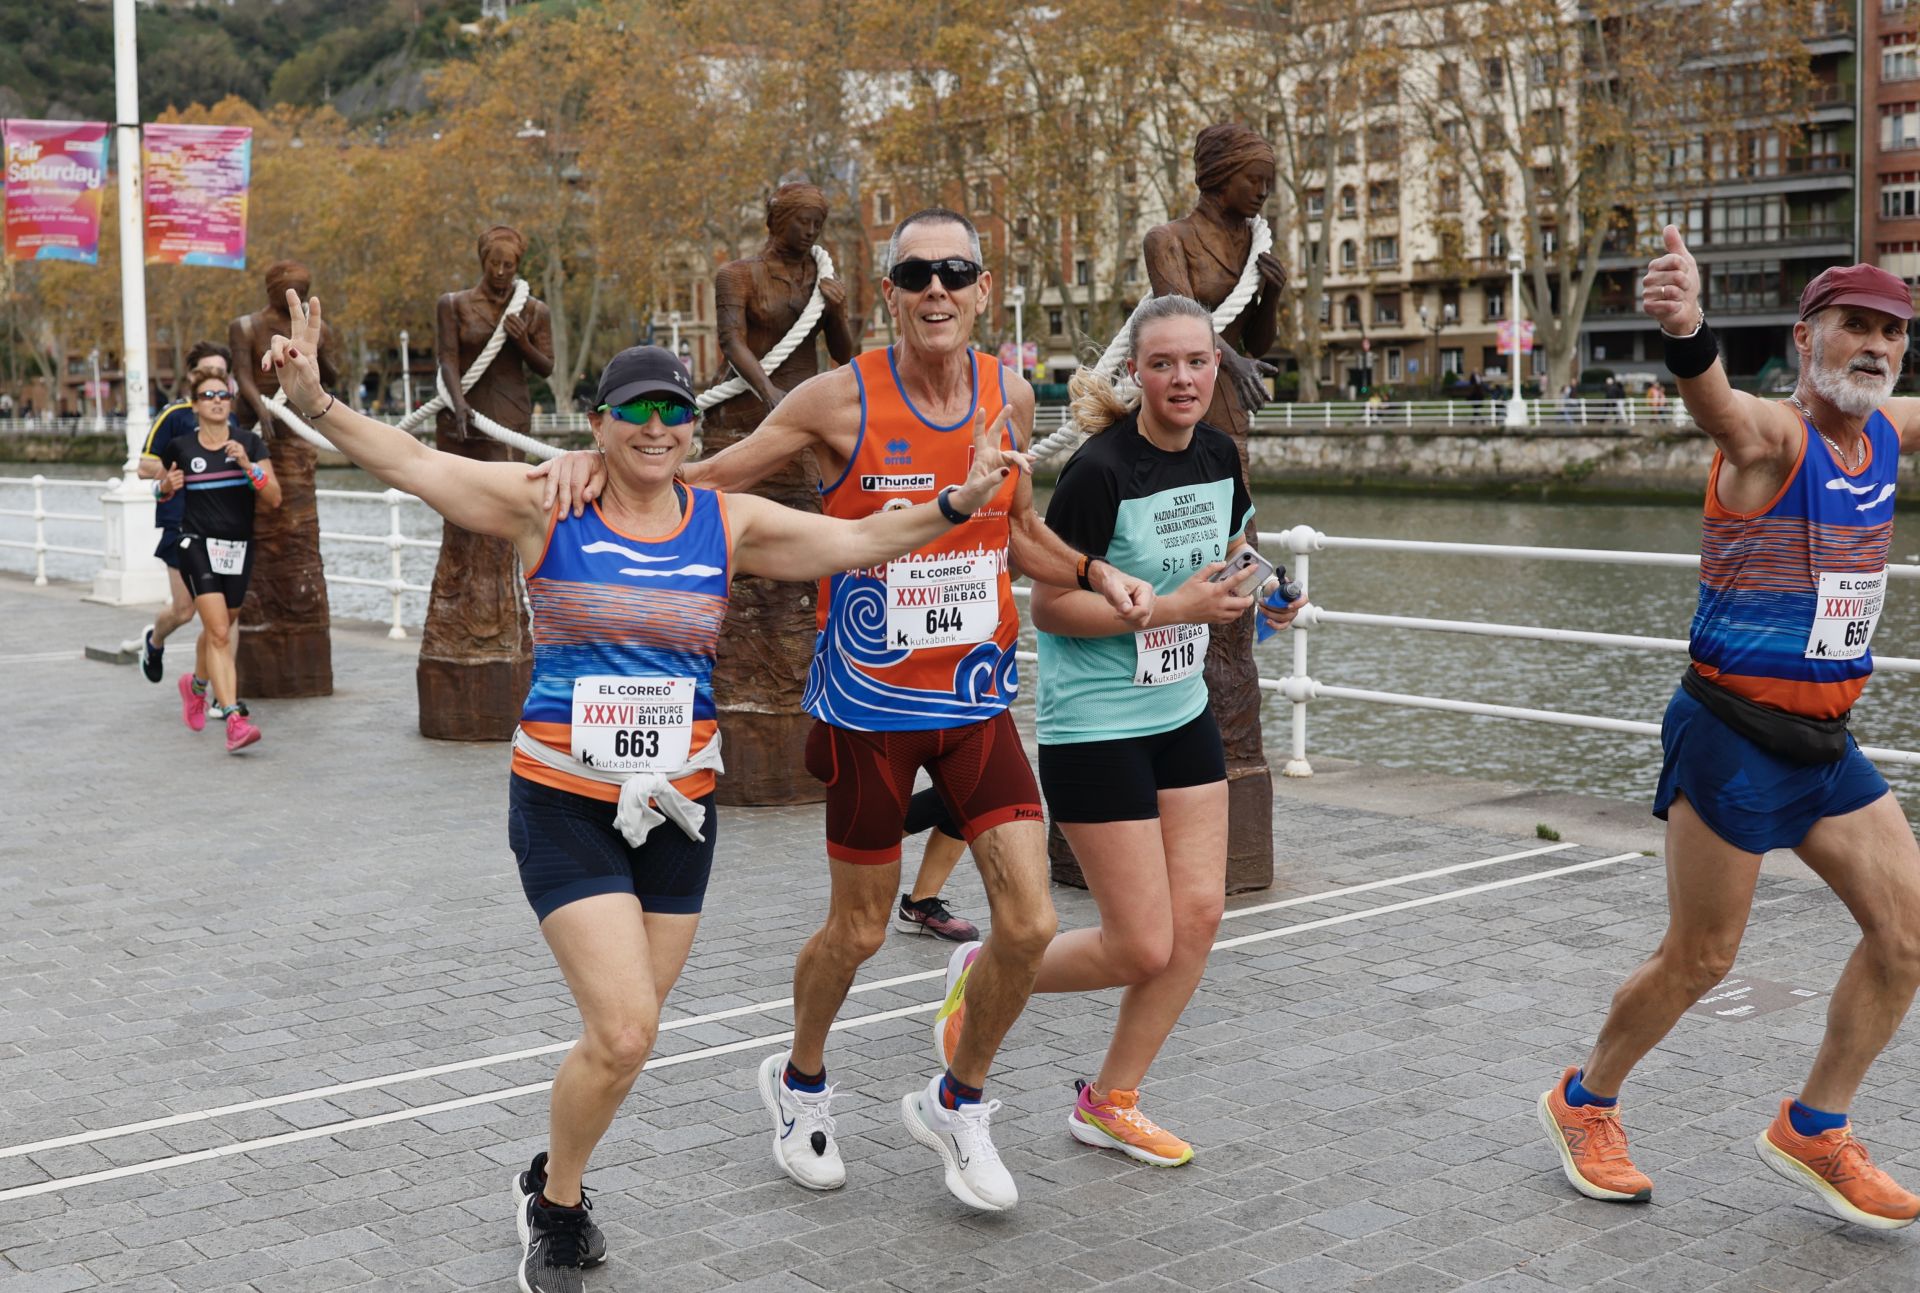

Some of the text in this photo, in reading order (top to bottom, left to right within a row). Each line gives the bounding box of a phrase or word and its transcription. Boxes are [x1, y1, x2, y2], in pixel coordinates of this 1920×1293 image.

[9, 141, 43, 161] Fair
[8, 161, 101, 189] Saturday
[876, 476, 933, 486] Thunder
[1173, 493, 1196, 506] XXXVI
[1153, 505, 1189, 522] NAZIOARTEKO
[1155, 521, 1183, 535] CARRERA
[911, 569, 925, 579] EL
[927, 565, 971, 579] CORREO
[1840, 580, 1852, 590] EL
[896, 582, 986, 607] XXXVI SANTURCE
[943, 590, 987, 603] BILBAO
[1824, 598, 1863, 617] XXXVI
[926, 606, 963, 635] 644
[910, 634, 957, 646] kutxabank
[1143, 627, 1177, 650] XXXVI
[1178, 627, 1203, 642] BILBAO
[1161, 642, 1194, 674] 2118
[1154, 669, 1188, 684] kutxabank
[599, 685, 671, 696] EL CORREO
[583, 704, 683, 725] XXXVI SANTURCE
[639, 715, 684, 725] BILBAO
[615, 729, 659, 758] 663
[596, 758, 651, 769] kutxabank
